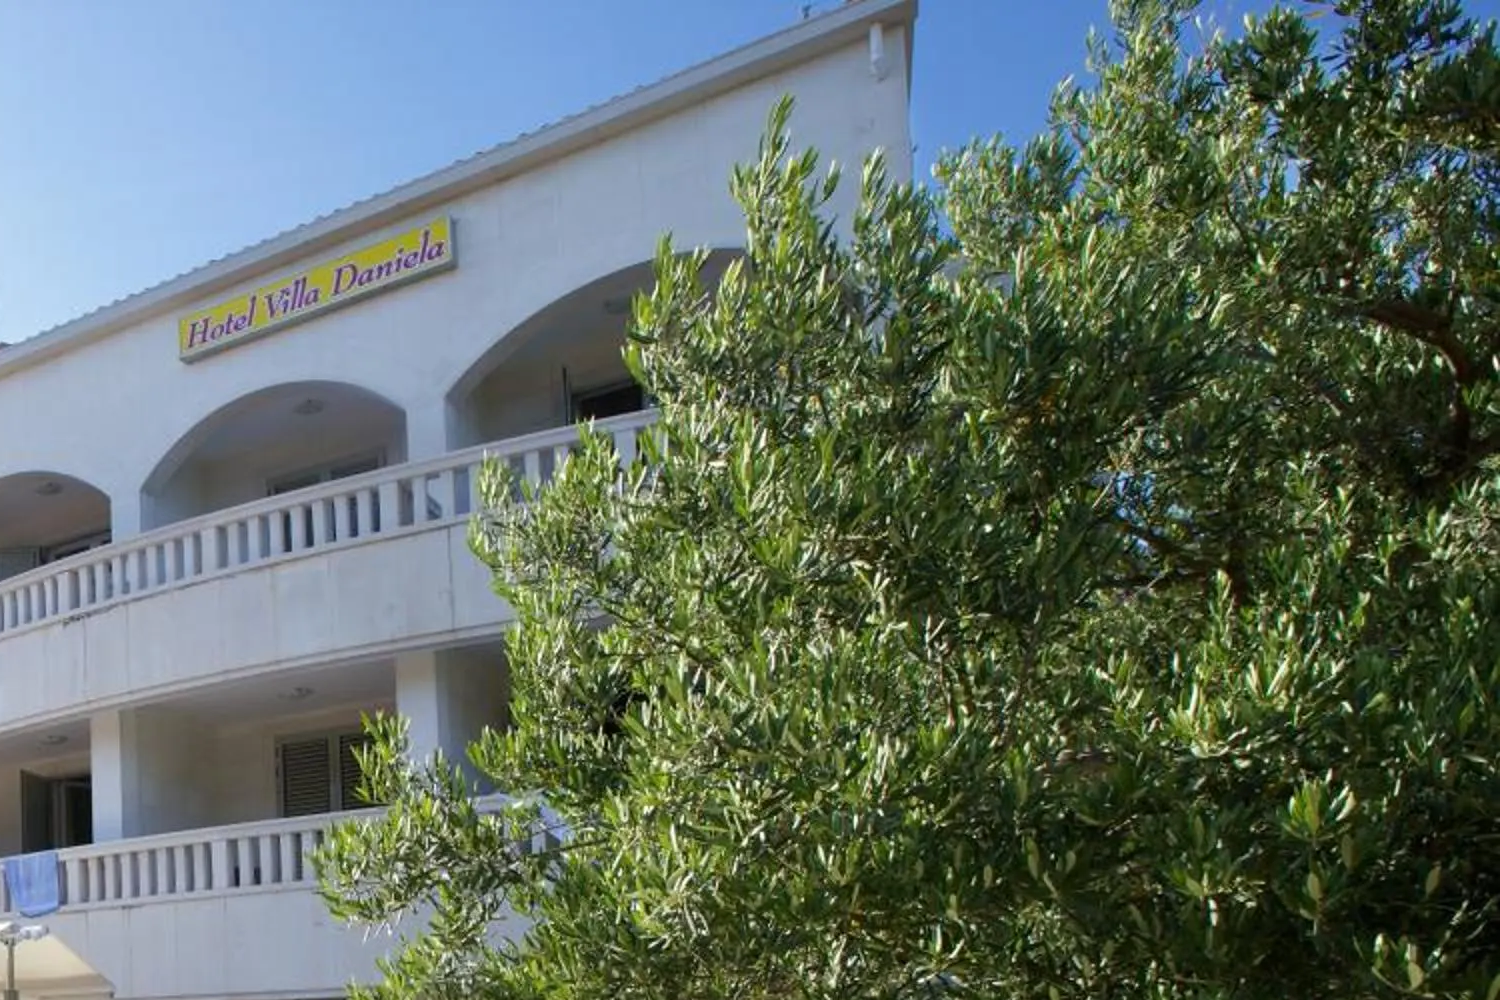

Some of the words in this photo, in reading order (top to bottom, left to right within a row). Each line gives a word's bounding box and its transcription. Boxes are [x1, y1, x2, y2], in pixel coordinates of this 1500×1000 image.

[187, 295, 257, 348] Hotel
[264, 275, 320, 319] Villa
[331, 230, 445, 296] Daniela
